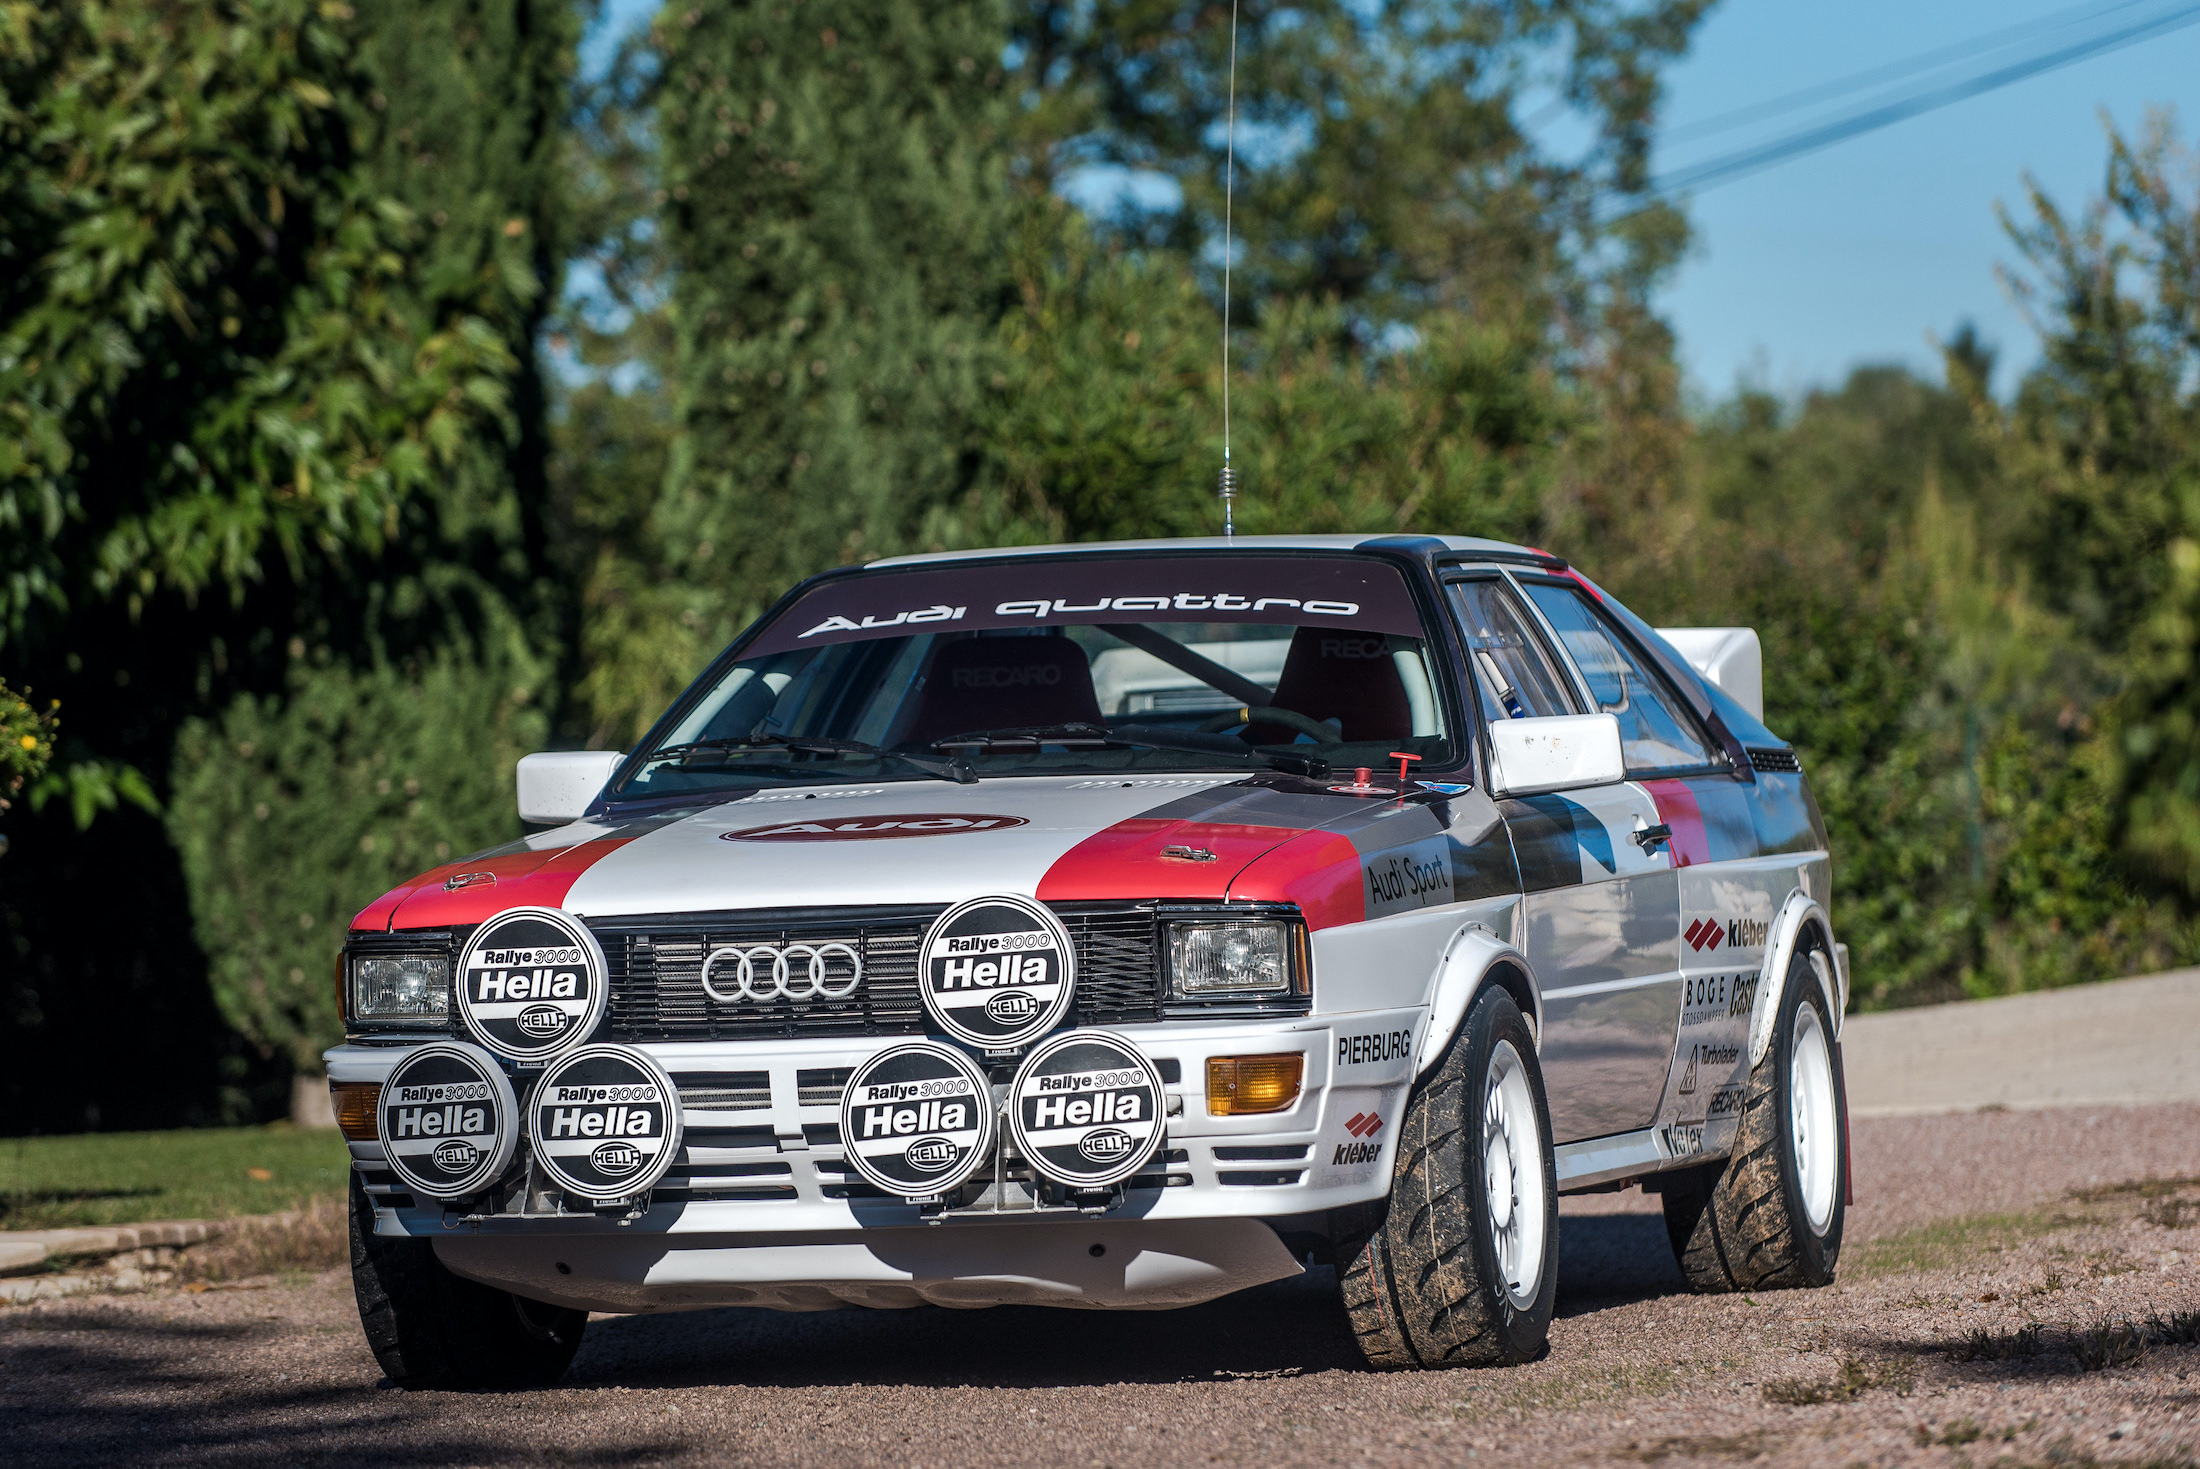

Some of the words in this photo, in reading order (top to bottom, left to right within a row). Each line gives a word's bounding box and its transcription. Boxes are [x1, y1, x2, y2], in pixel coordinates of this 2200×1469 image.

[995, 592, 1359, 618] quattro
[952, 664, 1062, 687] RECARO
[1368, 858, 1406, 904] Audi
[1405, 855, 1448, 904] Sport
[948, 937, 999, 953] Rallye
[1001, 934, 1051, 949] 3000
[484, 951, 532, 966] Rallye
[534, 949, 581, 964] 3000
[943, 955, 1047, 989] Hella
[478, 969, 577, 1000] Hella
[1686, 976, 1725, 1006] BOGE
[989, 999, 1039, 1014] HELLA
[521, 1013, 568, 1027] HELLA
[1338, 1029, 1411, 1066] PIERBURG
[1701, 1043, 1739, 1065] Turbolader
[868, 1085, 918, 1101] Rallye
[920, 1080, 969, 1096] 3000
[1040, 1075, 1092, 1091] Rallye
[1094, 1071, 1144, 1087] 3000
[401, 1087, 444, 1102] Rallye
[445, 1085, 488, 1099] 3000
[557, 1088, 607, 1102] Rallye
[608, 1086, 656, 1101] 3000
[863, 1102, 967, 1138] Hella
[1034, 1092, 1142, 1127] Hella
[397, 1105, 486, 1136] Hella
[551, 1107, 652, 1137] Hella
[436, 1149, 479, 1163] HELLA
[909, 1147, 958, 1162] HELLA
[1082, 1138, 1134, 1153] HELLA
[594, 1151, 641, 1165] HELLA
